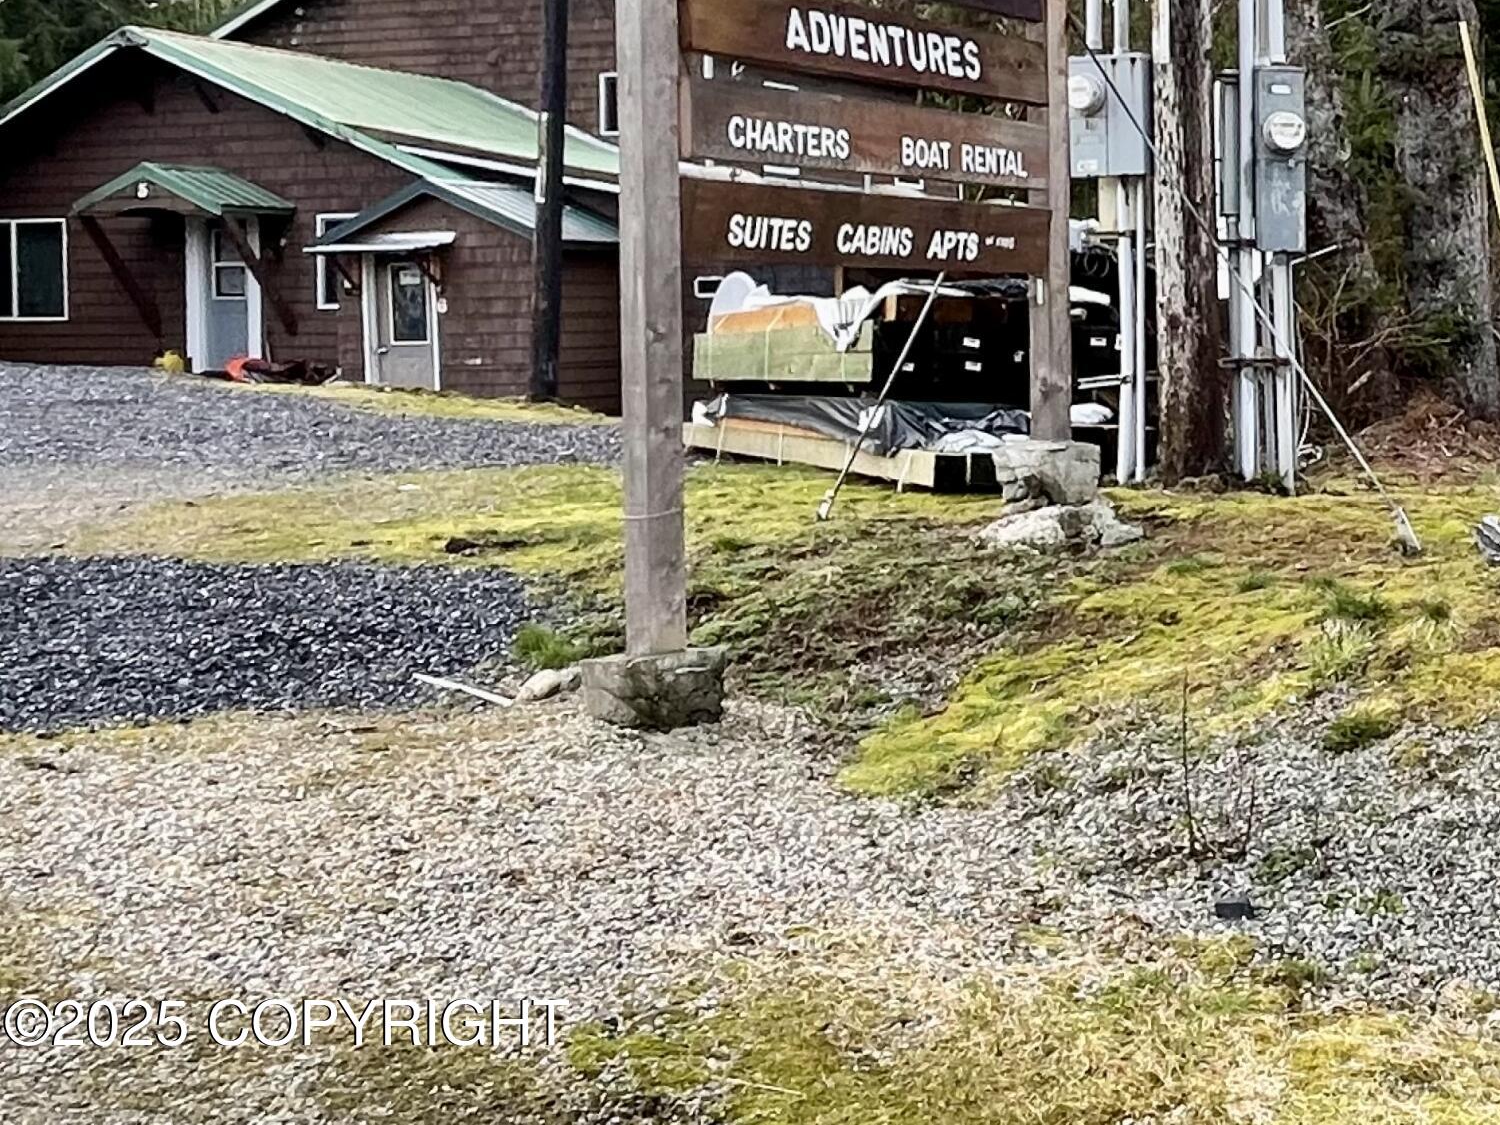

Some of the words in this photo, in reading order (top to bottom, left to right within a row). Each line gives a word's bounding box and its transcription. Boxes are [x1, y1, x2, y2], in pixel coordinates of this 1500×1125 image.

[786, 8, 981, 81] ADVENTURES
[727, 116, 851, 160] CHARTERS
[901, 136, 952, 170] BOAT
[961, 143, 1029, 178] RENTAL
[727, 214, 813, 251] SUITES
[836, 223, 914, 257] CABINS
[926, 230, 980, 260] APTS
